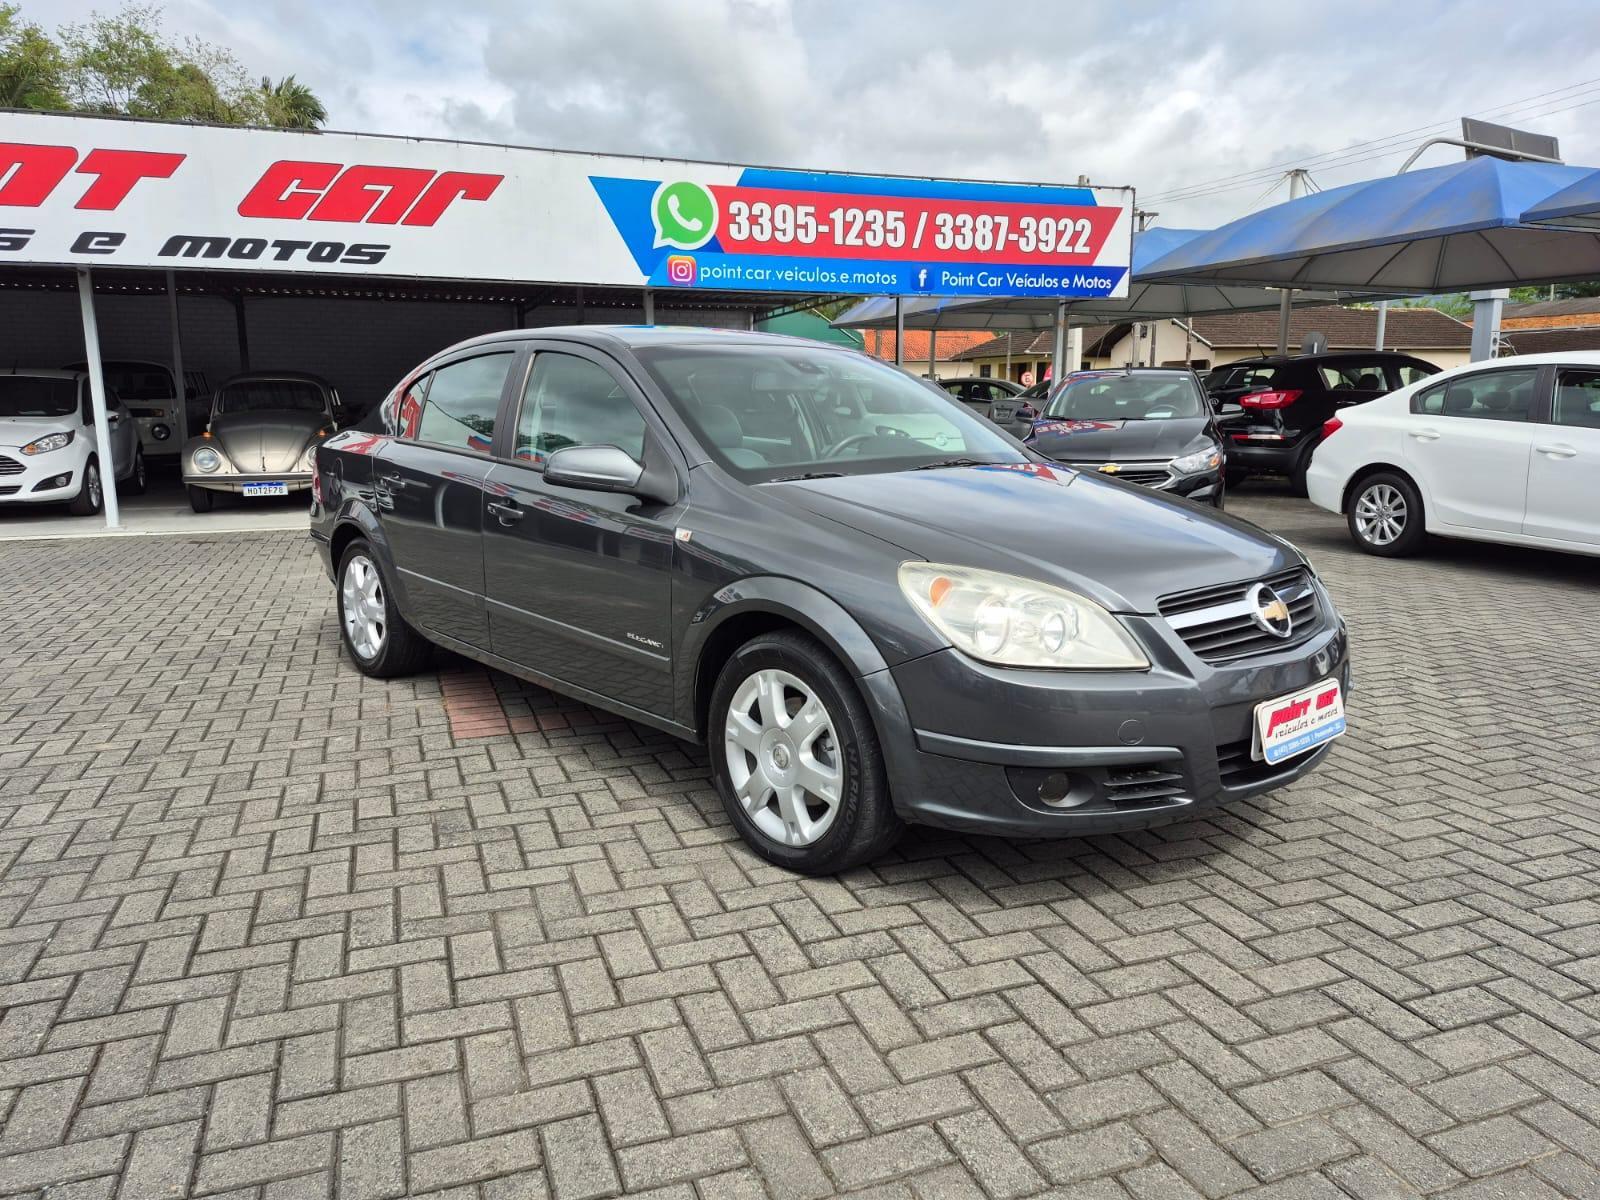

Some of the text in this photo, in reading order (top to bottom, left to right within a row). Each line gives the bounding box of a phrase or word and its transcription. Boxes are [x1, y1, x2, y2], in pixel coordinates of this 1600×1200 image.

[728, 200, 1092, 254] 3395-1235 / 3387-3922
[700, 263, 897, 286] point.car.veiculos.e.motos
[941, 271, 1112, 290] Point Car Veículos e Motos
